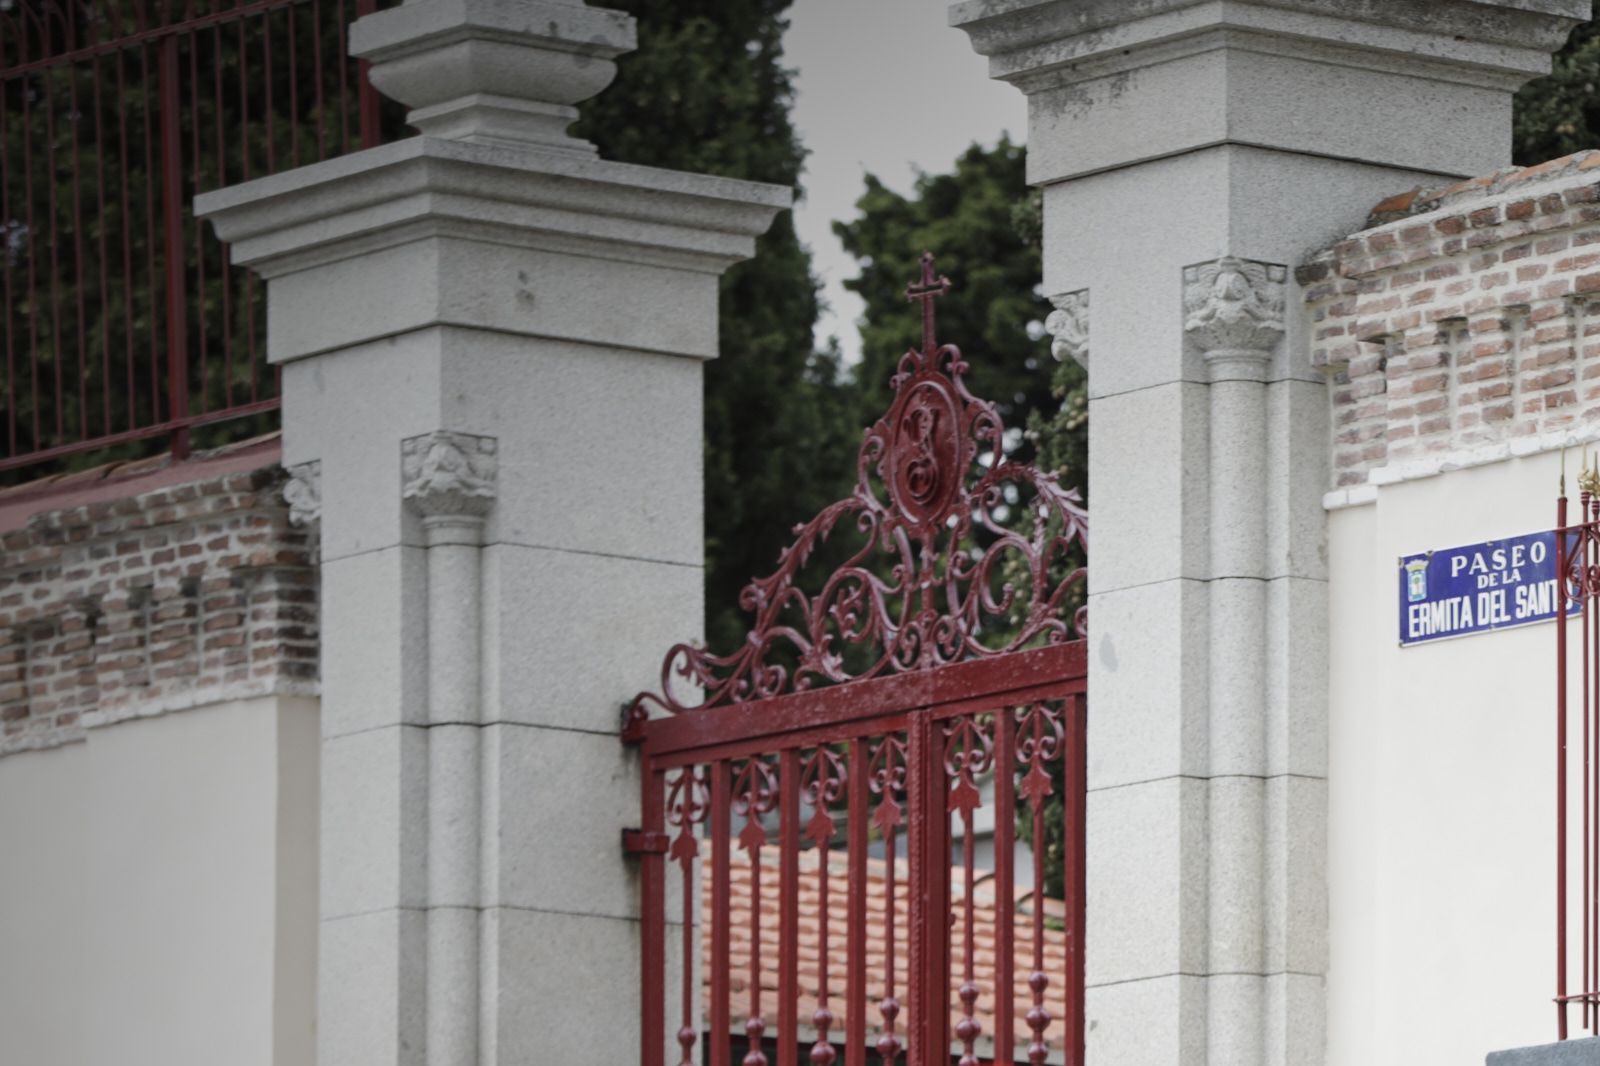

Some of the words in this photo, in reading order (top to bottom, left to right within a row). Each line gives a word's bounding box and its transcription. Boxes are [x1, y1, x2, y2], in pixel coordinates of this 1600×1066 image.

[1451, 541, 1546, 577] PASEO
[1477, 573, 1498, 589] DE
[1502, 567, 1521, 584] LA
[1408, 595, 1474, 638] ERMITA
[1477, 589, 1511, 626] DEL
